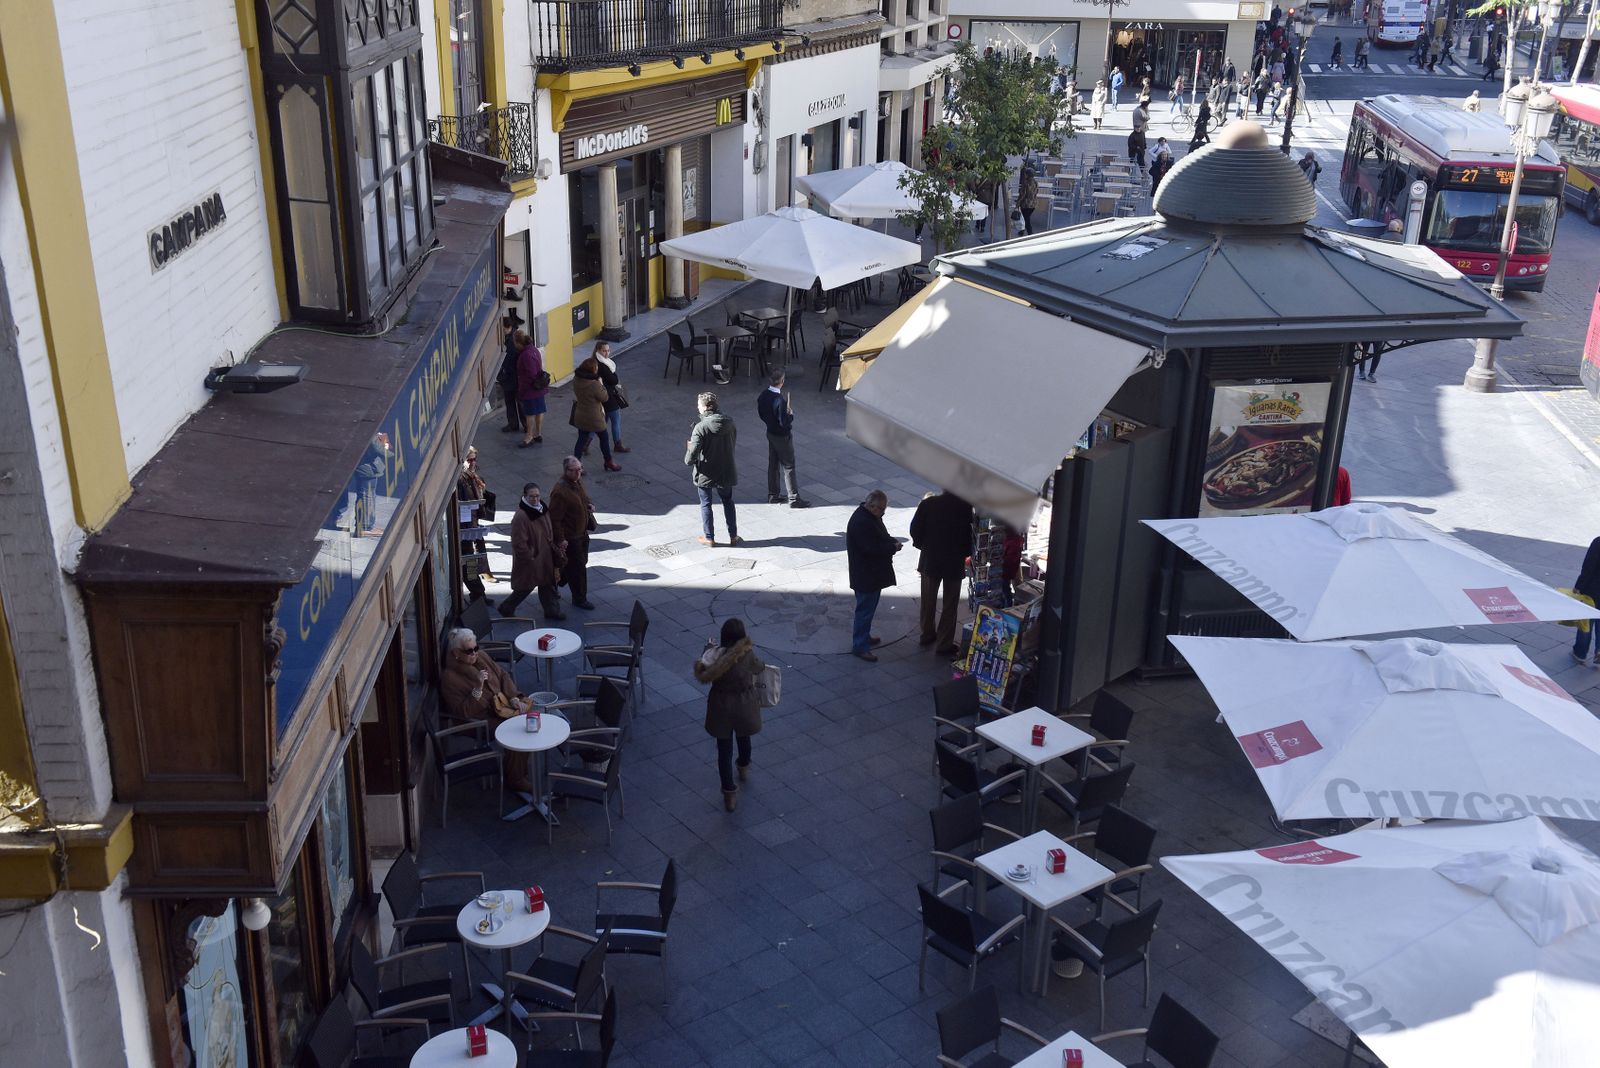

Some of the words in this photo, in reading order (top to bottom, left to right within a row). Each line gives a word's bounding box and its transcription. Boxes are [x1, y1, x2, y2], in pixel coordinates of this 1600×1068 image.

[1124, 21, 1165, 30] ZARA
[574, 124, 649, 160] McDonald's
[1461, 169, 1479, 182] 27
[151, 192, 226, 268] CAMPANA
[1456, 260, 1472, 269] 122
[385, 418, 405, 498] LA
[409, 314, 460, 450] CAMPANA
[1249, 402, 1276, 416] Iguanas
[1277, 401, 1297, 416] Ranas
